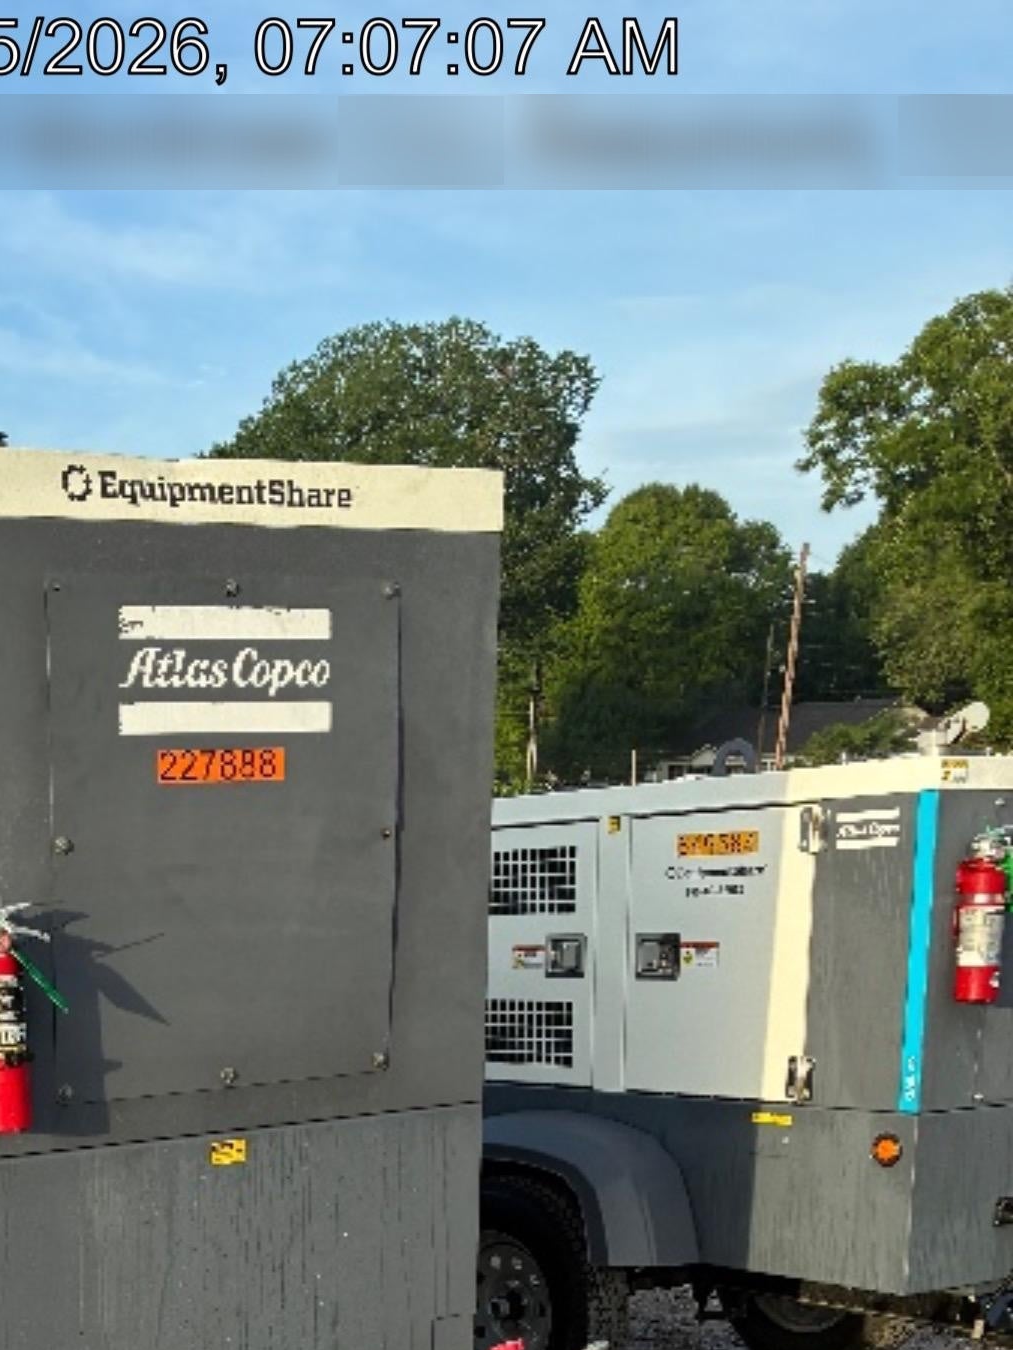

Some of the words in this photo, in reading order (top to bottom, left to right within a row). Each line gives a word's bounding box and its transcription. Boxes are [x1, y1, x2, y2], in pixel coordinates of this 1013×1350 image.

[98, 470, 352, 508] EquipmentShare
[118, 647, 228, 688] Atlas
[232, 647, 330, 697] Copco
